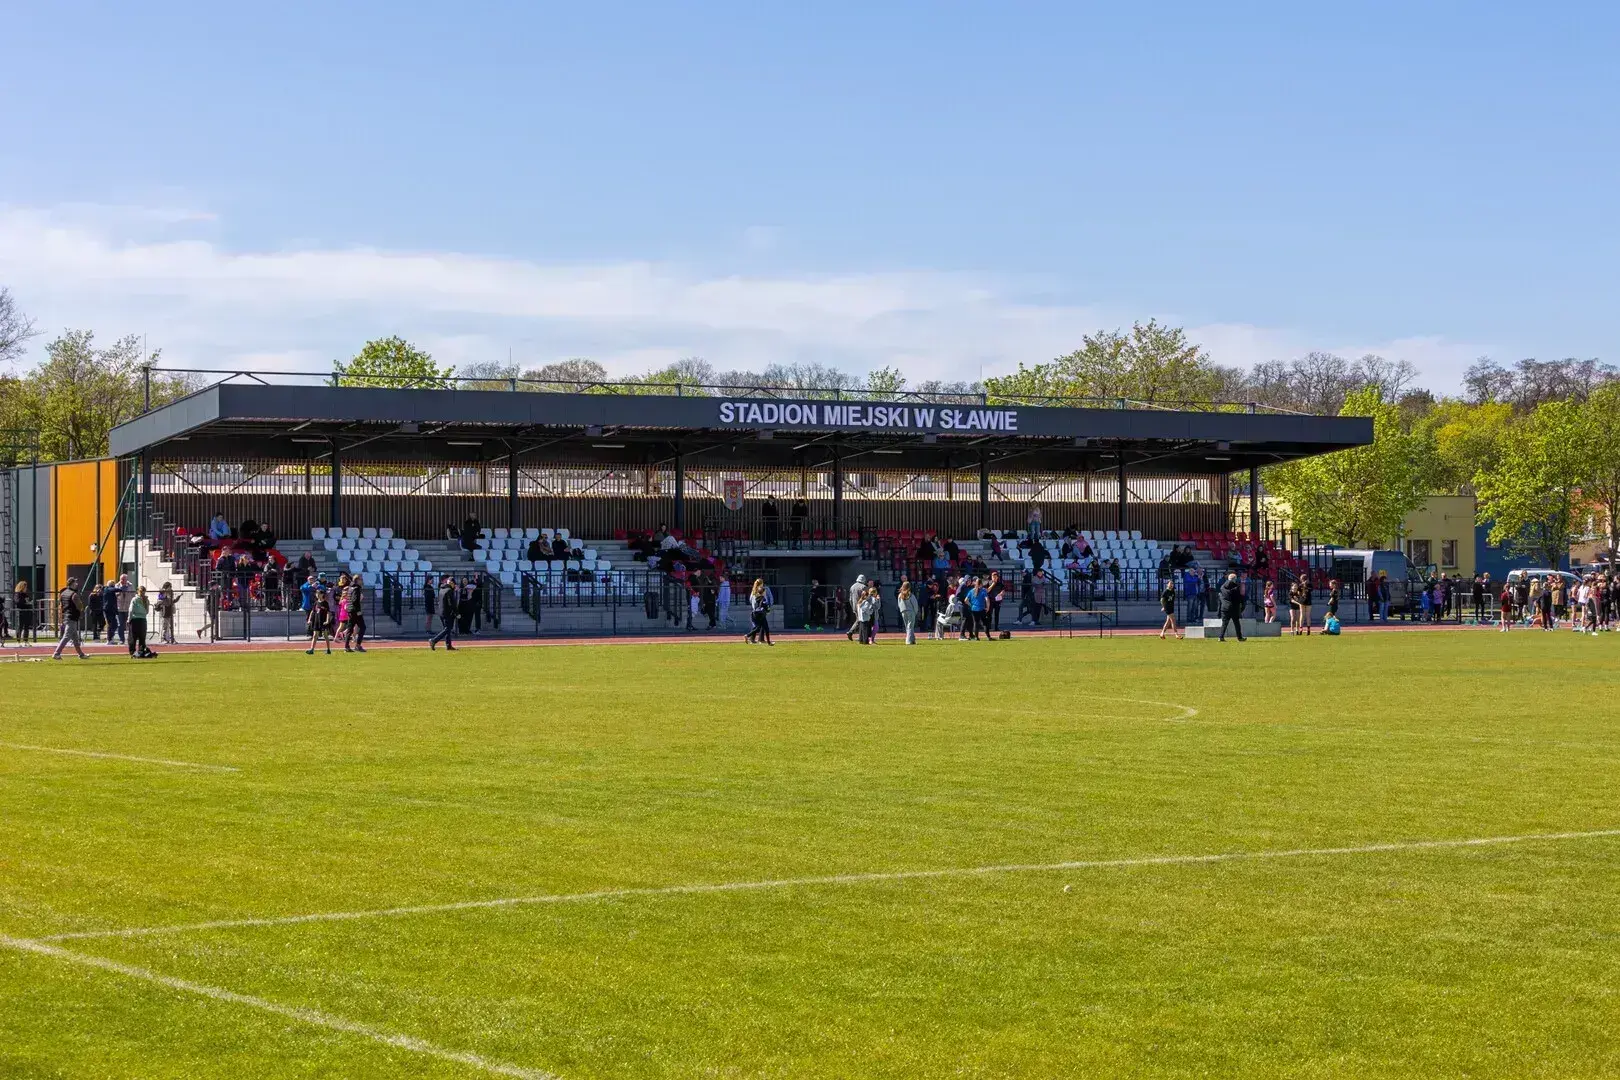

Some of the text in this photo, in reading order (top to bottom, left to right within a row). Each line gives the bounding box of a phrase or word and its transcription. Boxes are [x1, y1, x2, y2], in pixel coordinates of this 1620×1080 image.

[719, 402, 1018, 430] STADION MIEJSKI W SŁAWIE
